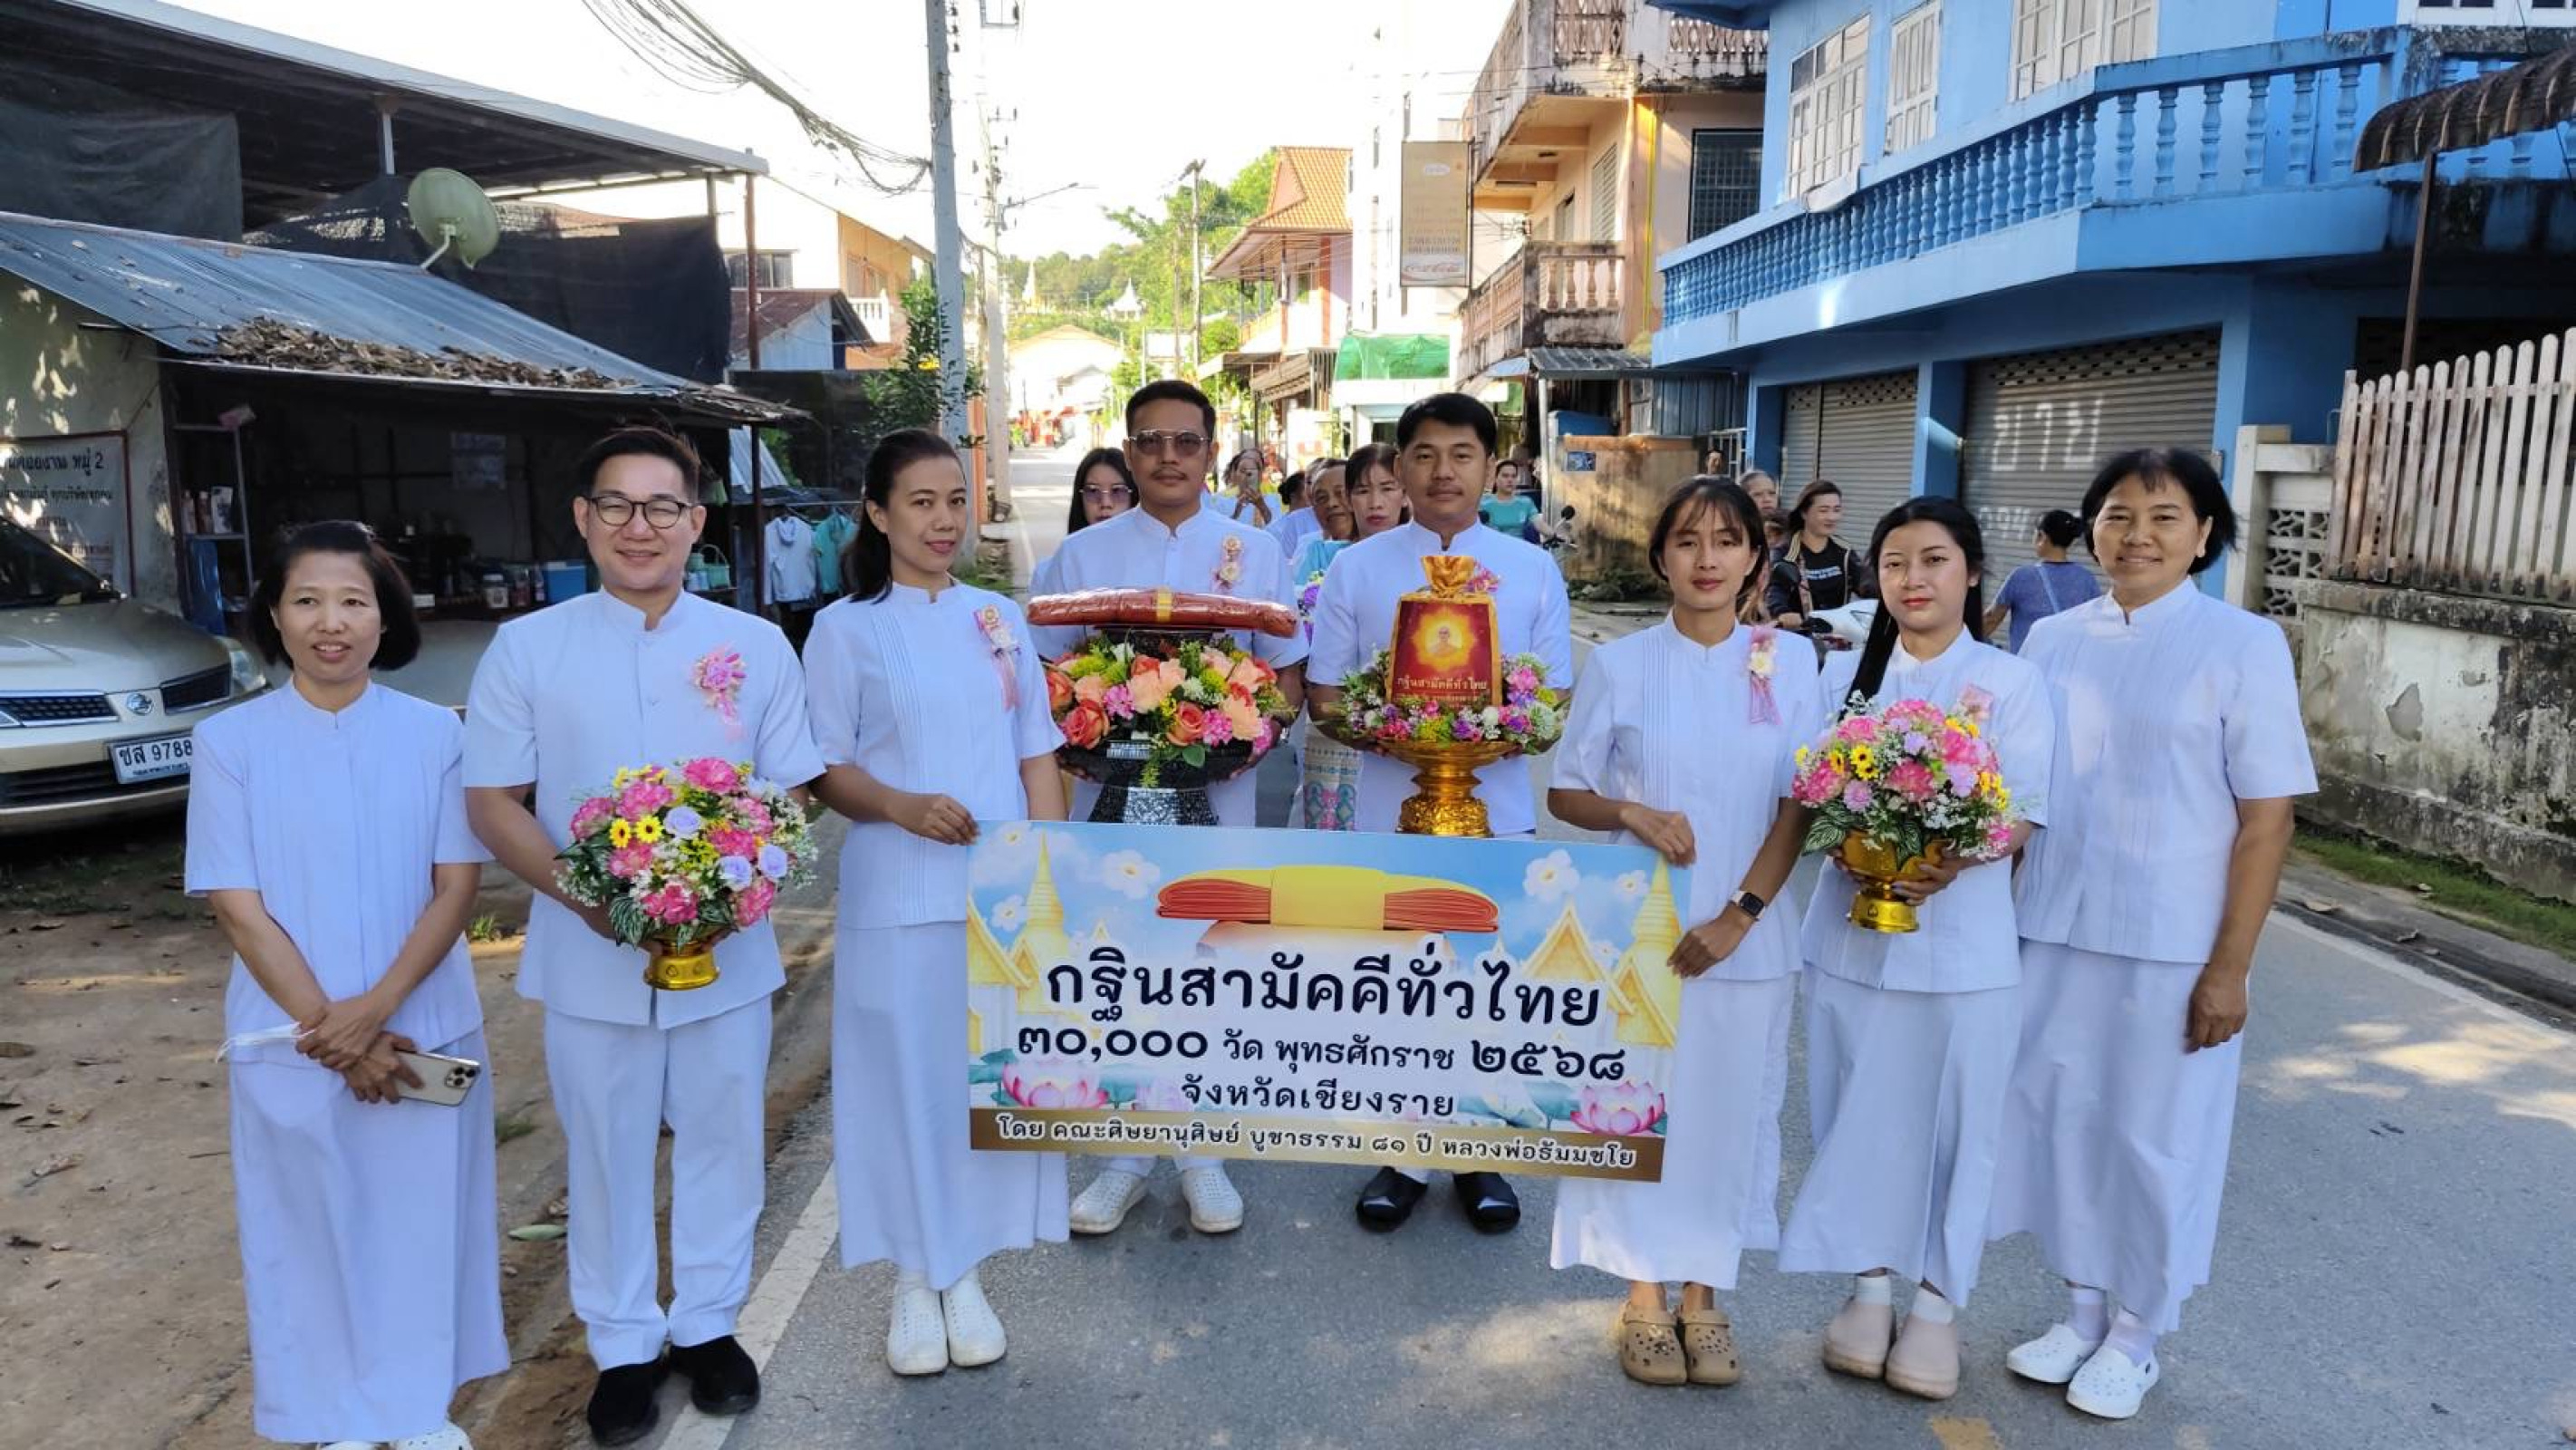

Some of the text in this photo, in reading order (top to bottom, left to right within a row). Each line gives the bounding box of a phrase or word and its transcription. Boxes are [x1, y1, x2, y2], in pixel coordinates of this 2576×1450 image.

[95, 451, 104, 469] 2
[1992, 399, 2103, 471] ขาย
[151, 739, 193, 761] 9788
[1047, 942, 1600, 1026] กฐินสามัคคีทั่วไทย
[1222, 1028, 1263, 1061] วัด
[1275, 1033, 1454, 1074] พุทธศักราช
[1471, 1039, 1626, 1081] ๒๕๖๘
[1181, 1073, 1453, 1116] จังหวัดเชียงราย
[999, 1116, 1043, 1138] โดย
[1053, 1119, 1240, 1148] คณะศิษยานุศิษย์
[1250, 1131, 1361, 1152] บูชาธรรม
[1415, 1133, 1432, 1154] ปี
[1442, 1137, 1635, 1166] หลวงพ่อธัมมชโย
